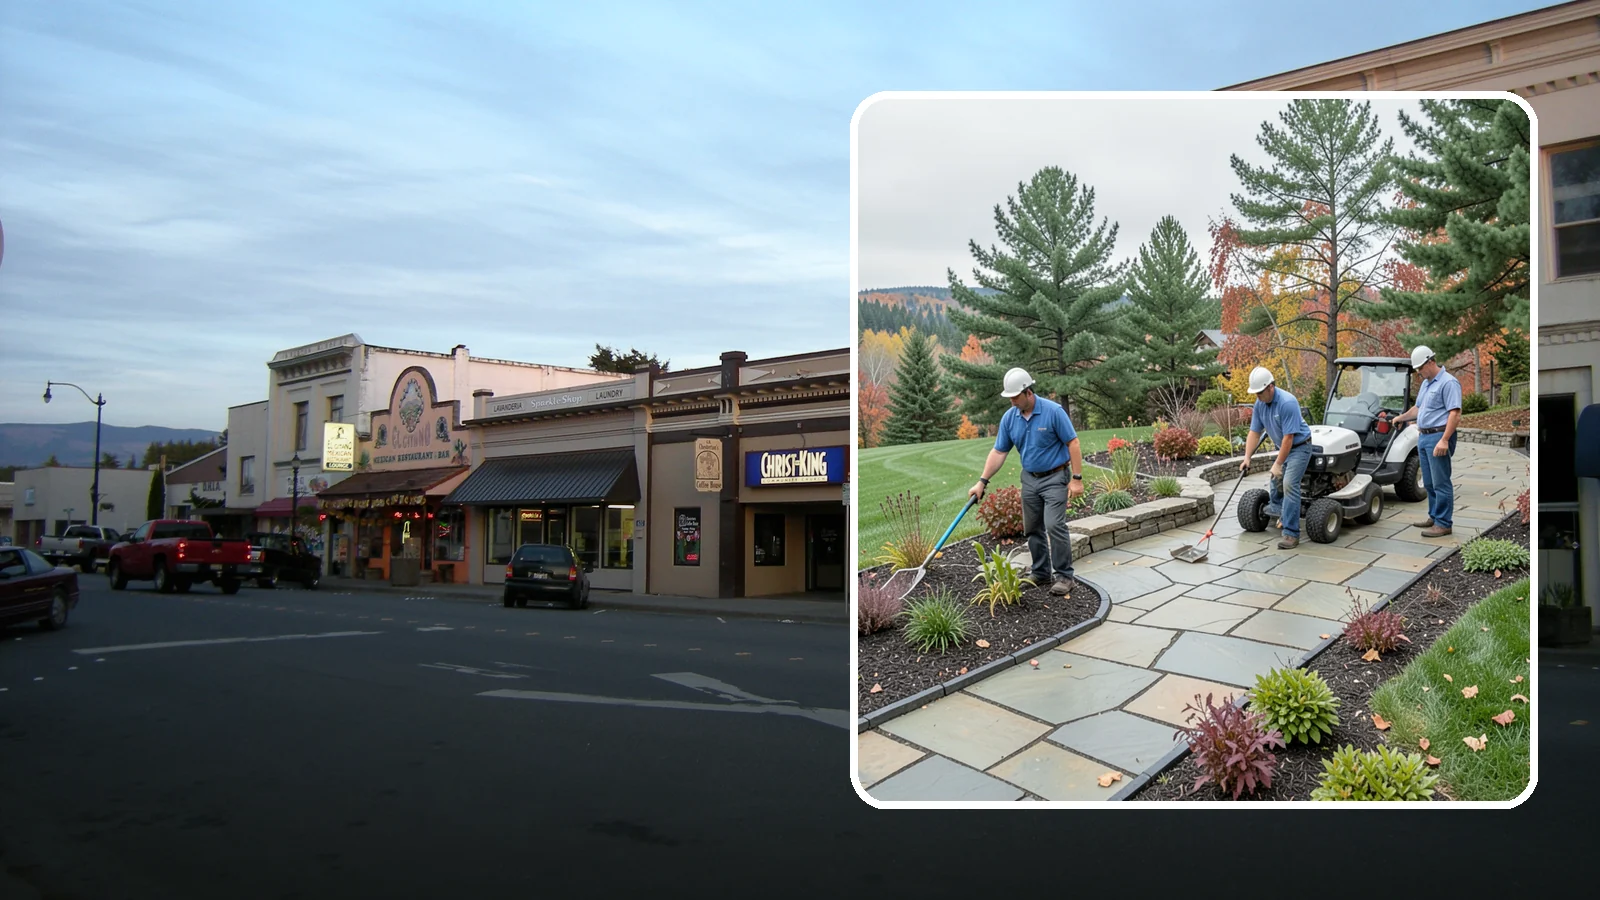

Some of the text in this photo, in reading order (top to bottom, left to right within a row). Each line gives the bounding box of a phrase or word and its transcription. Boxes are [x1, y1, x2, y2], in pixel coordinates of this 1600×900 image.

[493, 388, 624, 413] LAVANDERIA Sparkle Shop LAUNDRY
[374, 454, 396, 464] MEXICAN
[397, 451, 434, 462] RESTAURANT
[438, 450, 451, 459] BAR
[798, 449, 828, 476] KING
